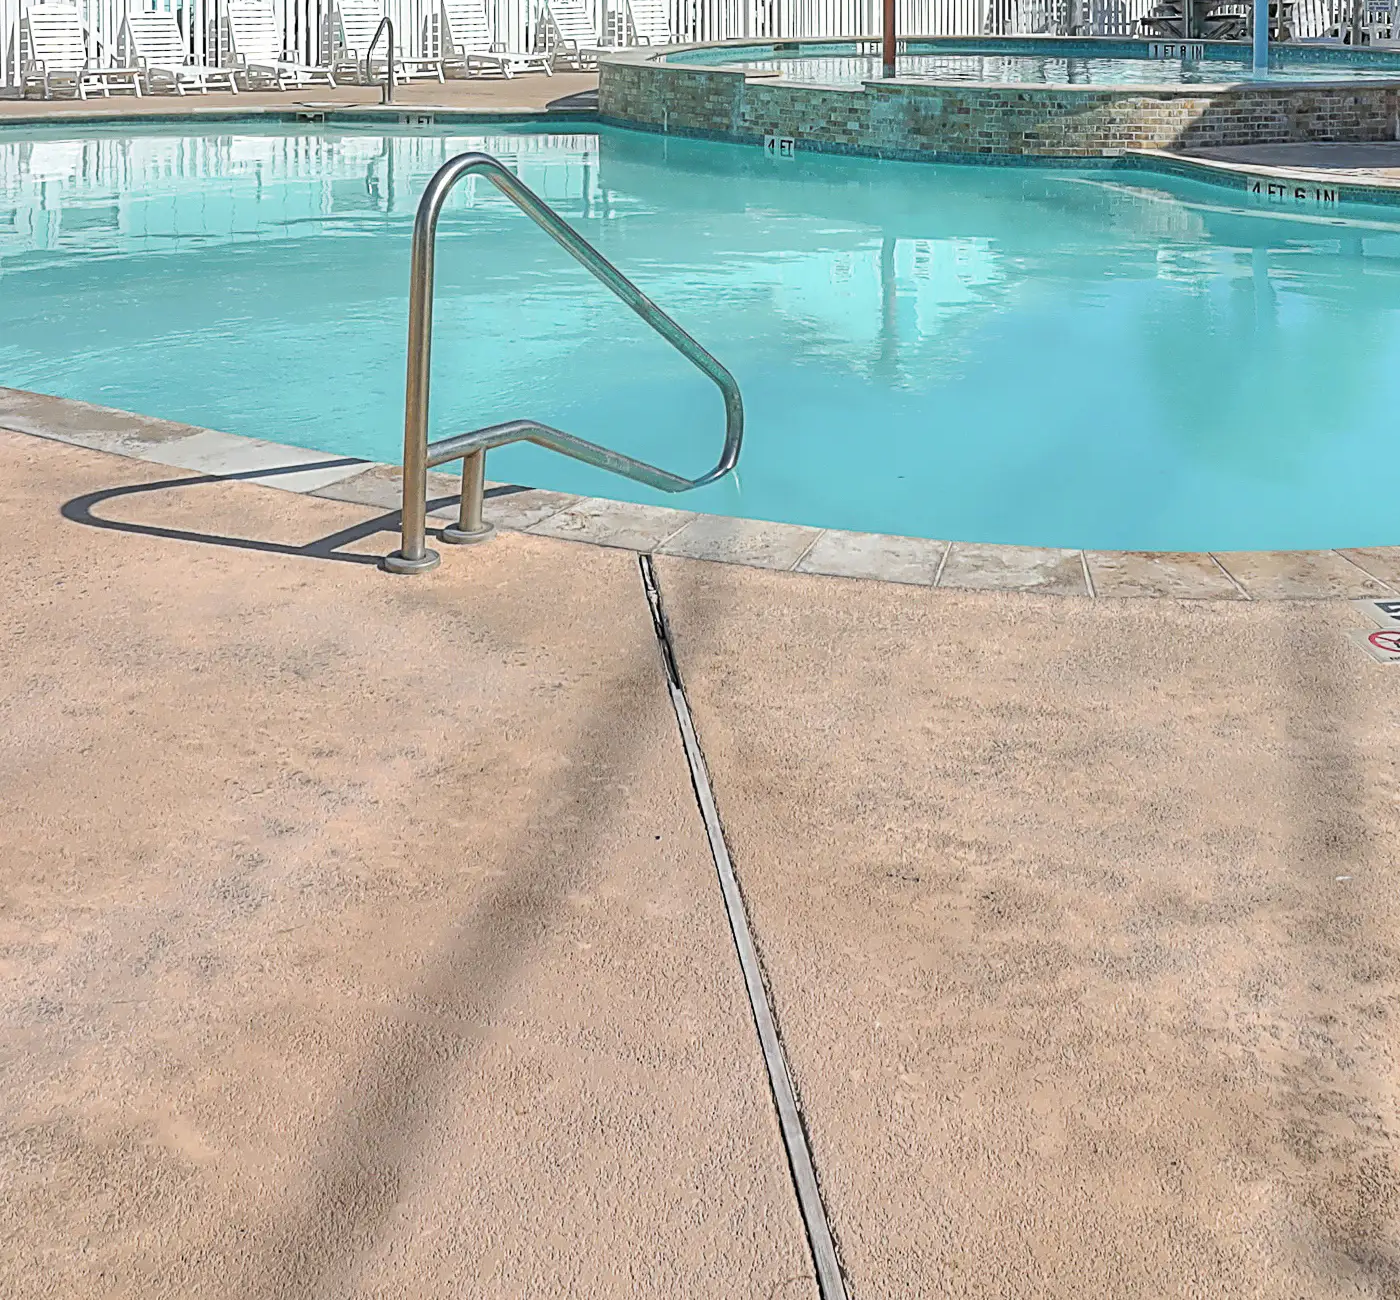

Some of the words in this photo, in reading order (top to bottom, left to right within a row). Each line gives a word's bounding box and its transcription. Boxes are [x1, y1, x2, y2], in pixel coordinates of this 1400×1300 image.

[1164, 44, 1175, 58] FT
[1192, 45, 1202, 60] IN
[780, 140, 793, 151] FT
[1268, 184, 1286, 197] FT
[1316, 188, 1335, 202] IN
